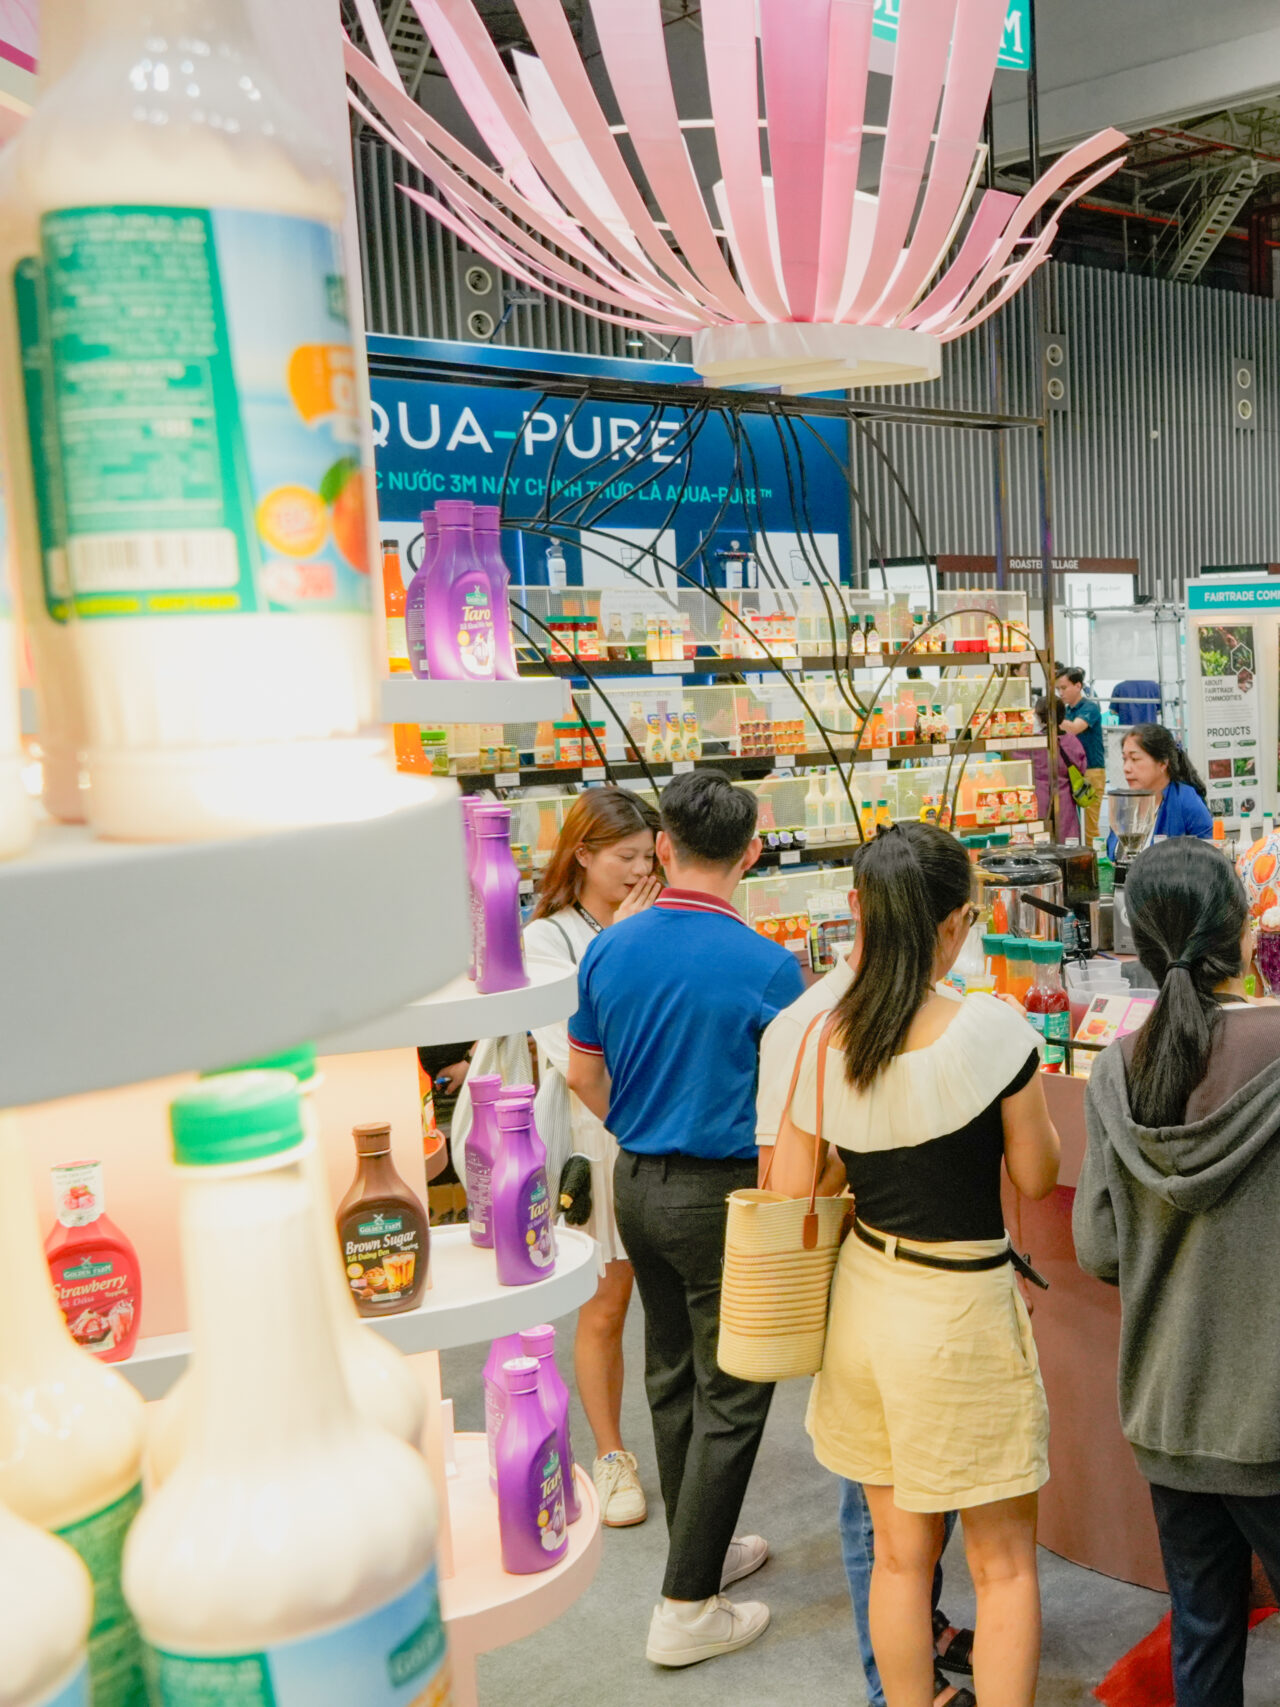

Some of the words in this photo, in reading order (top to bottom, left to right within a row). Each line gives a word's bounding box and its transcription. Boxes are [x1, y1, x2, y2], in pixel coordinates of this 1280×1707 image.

[389, 467, 445, 492] NƯỚC
[450, 474, 477, 493] 3M
[482, 476, 521, 495] NAY
[525, 475, 582, 498] CHÍNH
[639, 480, 661, 500] LÀ
[1010, 559, 1042, 569] ROASTE
[1204, 591, 1254, 602] FAIRTRADE
[462, 605, 491, 621] Taro
[1207, 726, 1251, 737] PRODUCTS
[346, 1240, 380, 1255] Brown
[383, 1231, 416, 1248] Sugar
[55, 1275, 127, 1300] Strawberry
[540, 1465, 562, 1499] Tar
